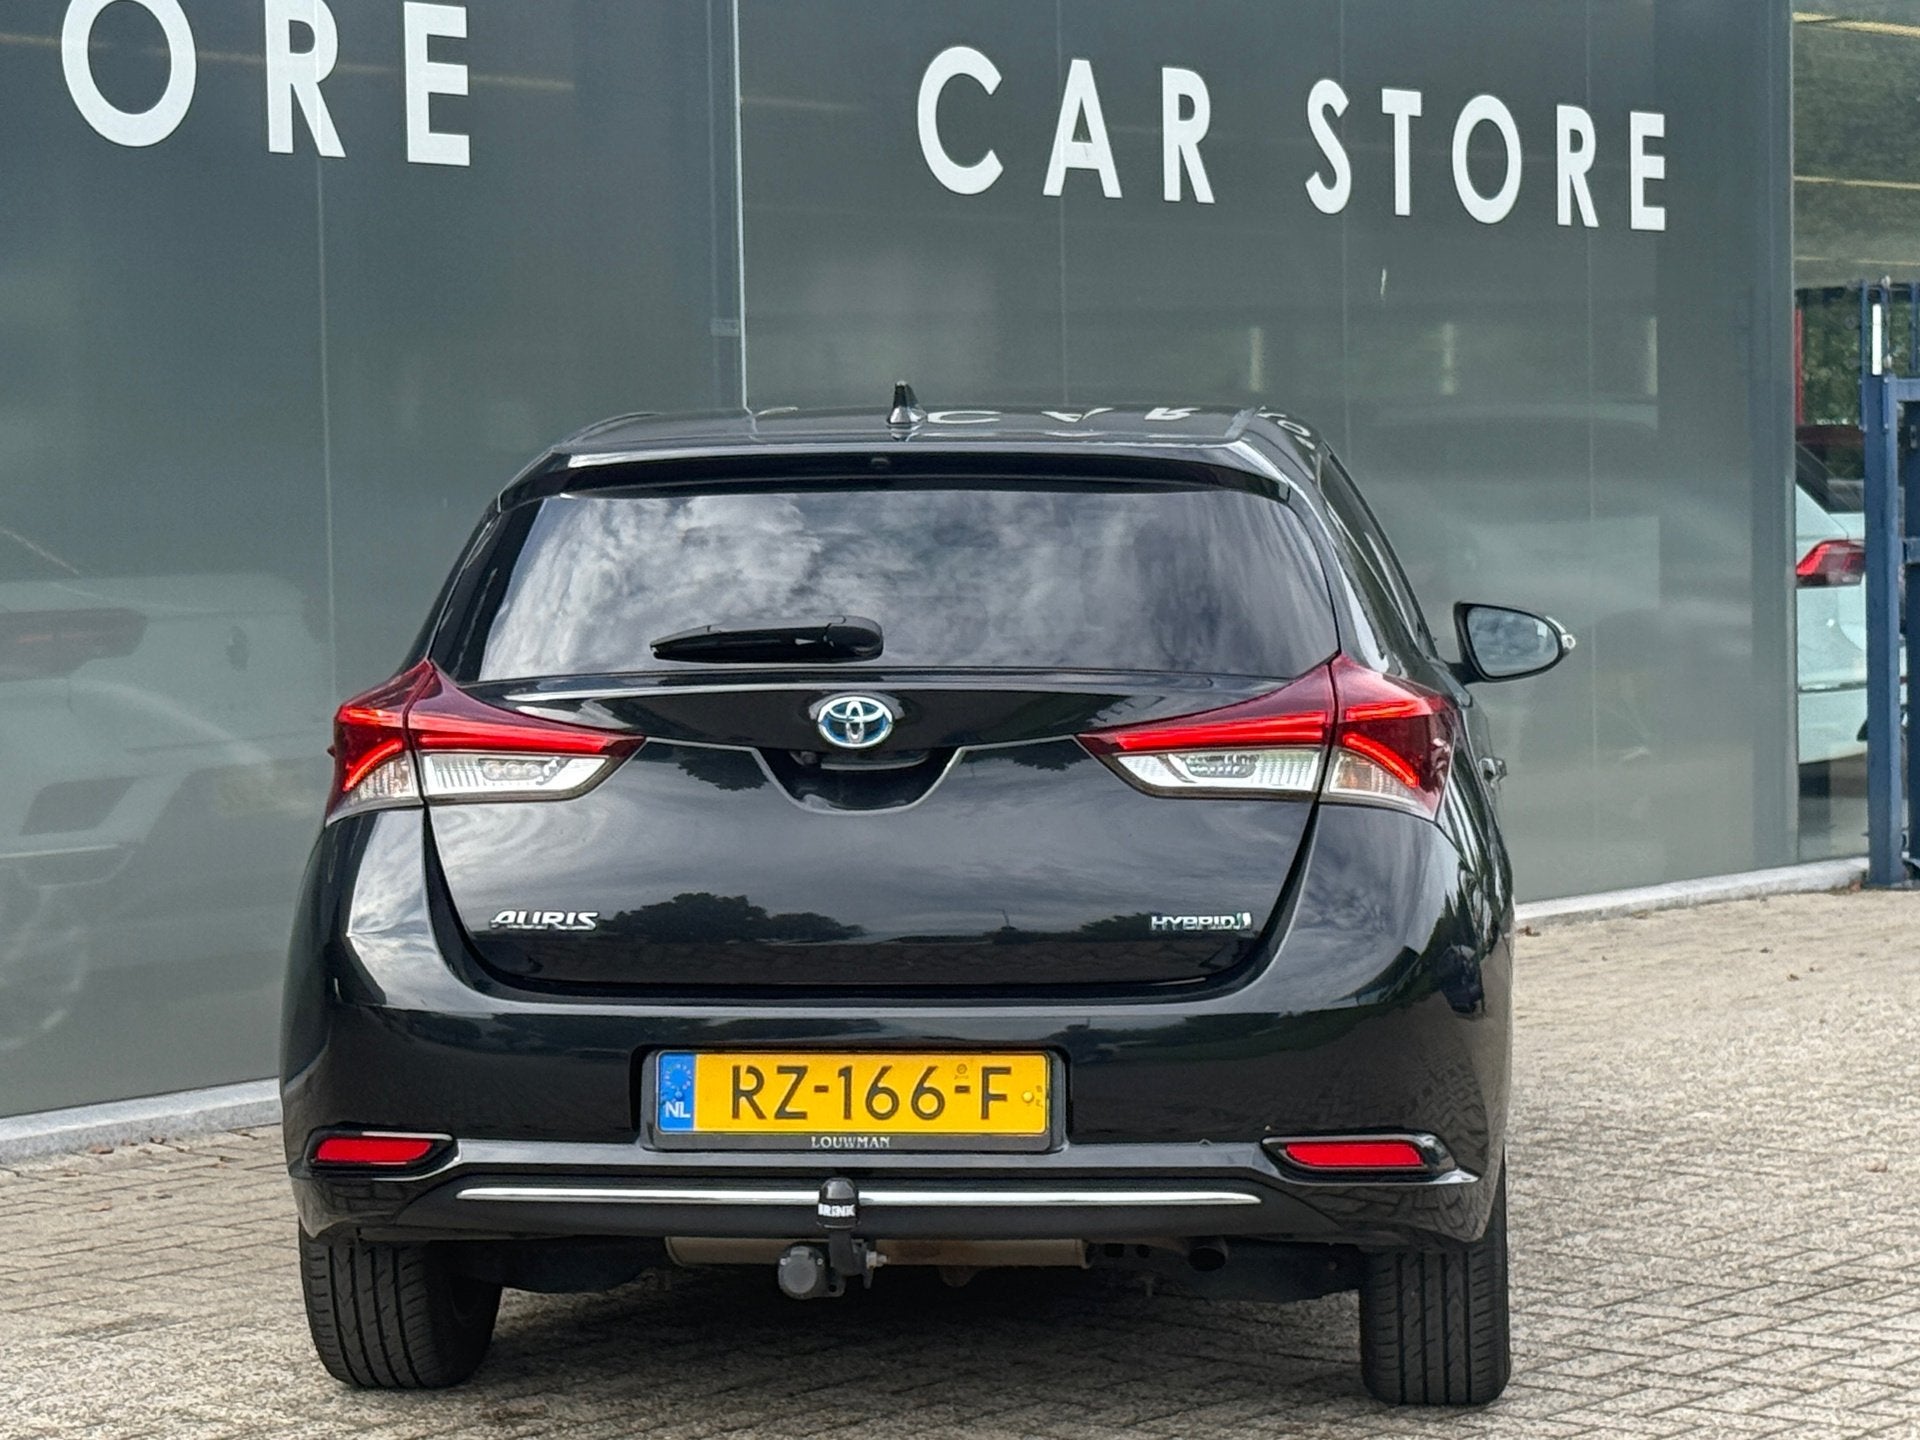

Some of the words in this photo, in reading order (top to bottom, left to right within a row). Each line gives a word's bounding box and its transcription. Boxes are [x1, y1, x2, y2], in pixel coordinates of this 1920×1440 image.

[917, 46, 1215, 204] CAR
[1305, 78, 1666, 231] STORE
[490, 910, 599, 930] AURIS
[1150, 914, 1240, 931] HYBRID
[731, 1064, 1012, 1121] RZ-166-F
[665, 1101, 691, 1118] NL
[811, 1136, 890, 1149] LOUWMAN
